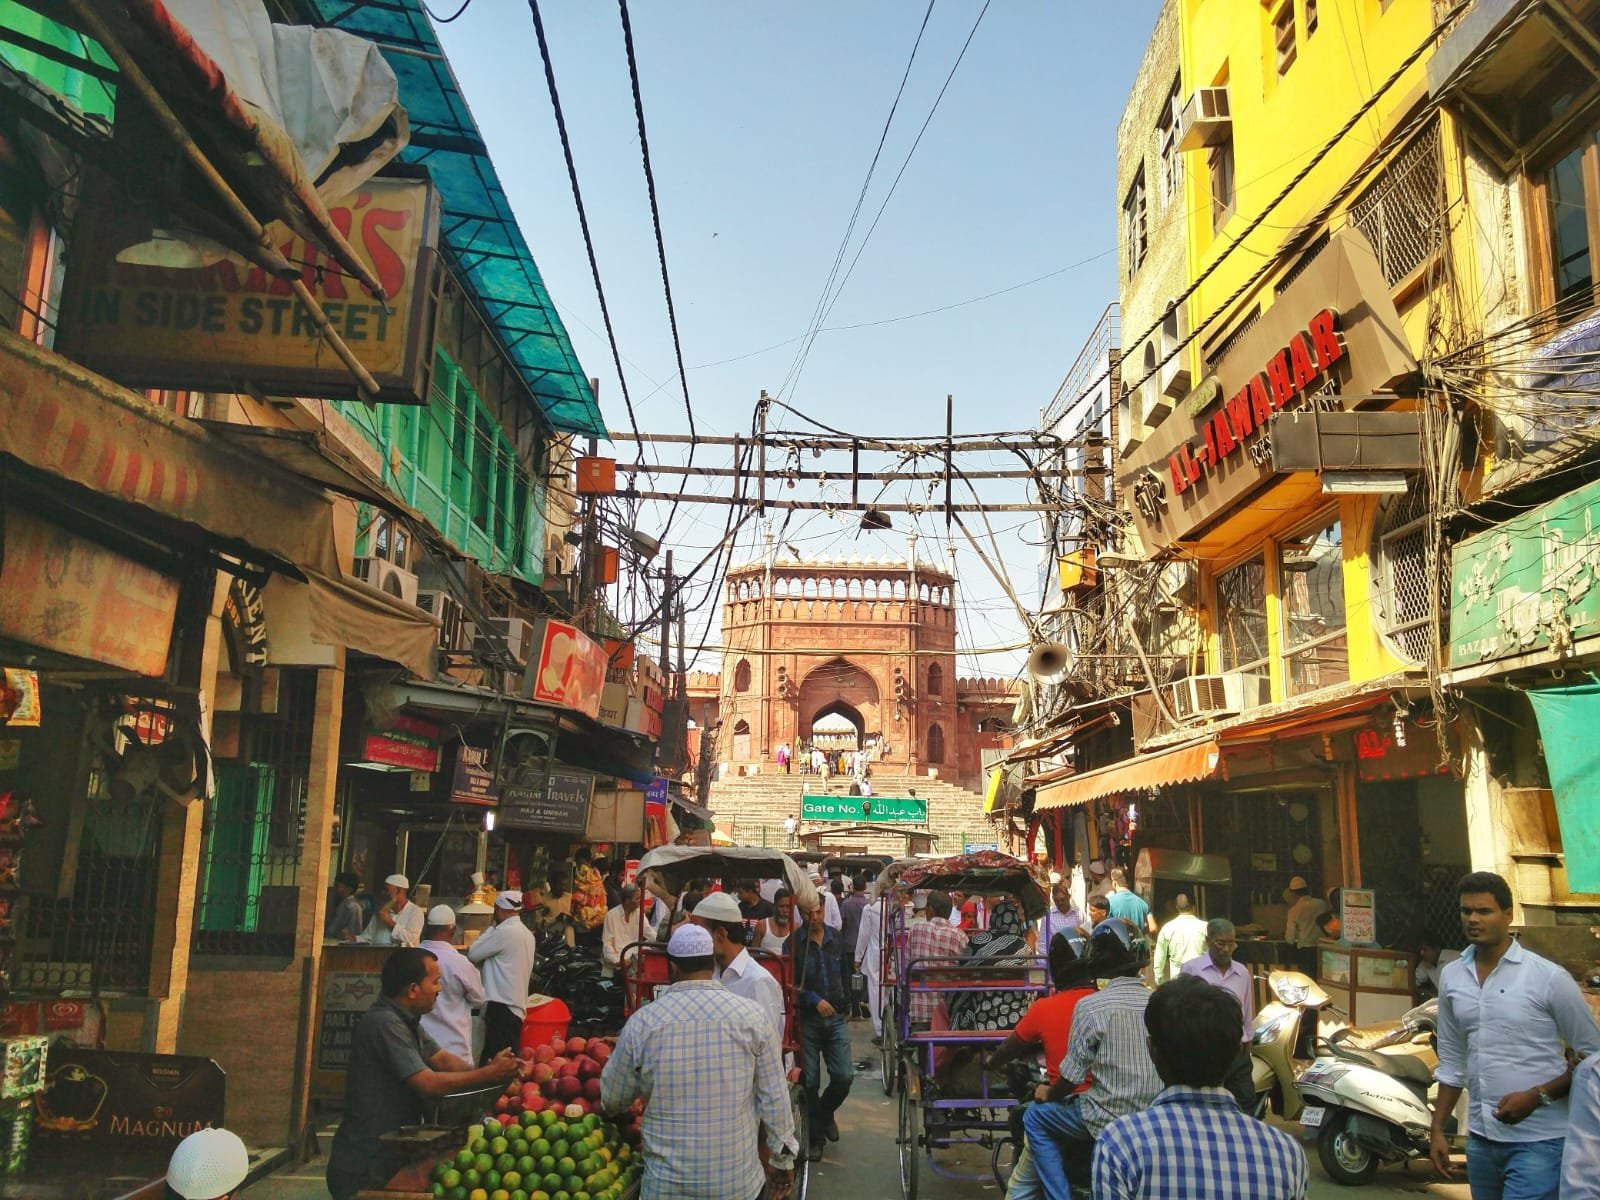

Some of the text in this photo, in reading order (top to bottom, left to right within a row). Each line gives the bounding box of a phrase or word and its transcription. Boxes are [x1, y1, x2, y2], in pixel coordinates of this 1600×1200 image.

[82, 287, 397, 343] IN SIDE STREET
[1168, 308, 1346, 496] AL-JAWAHAR
[803, 803, 835, 813] Gate
